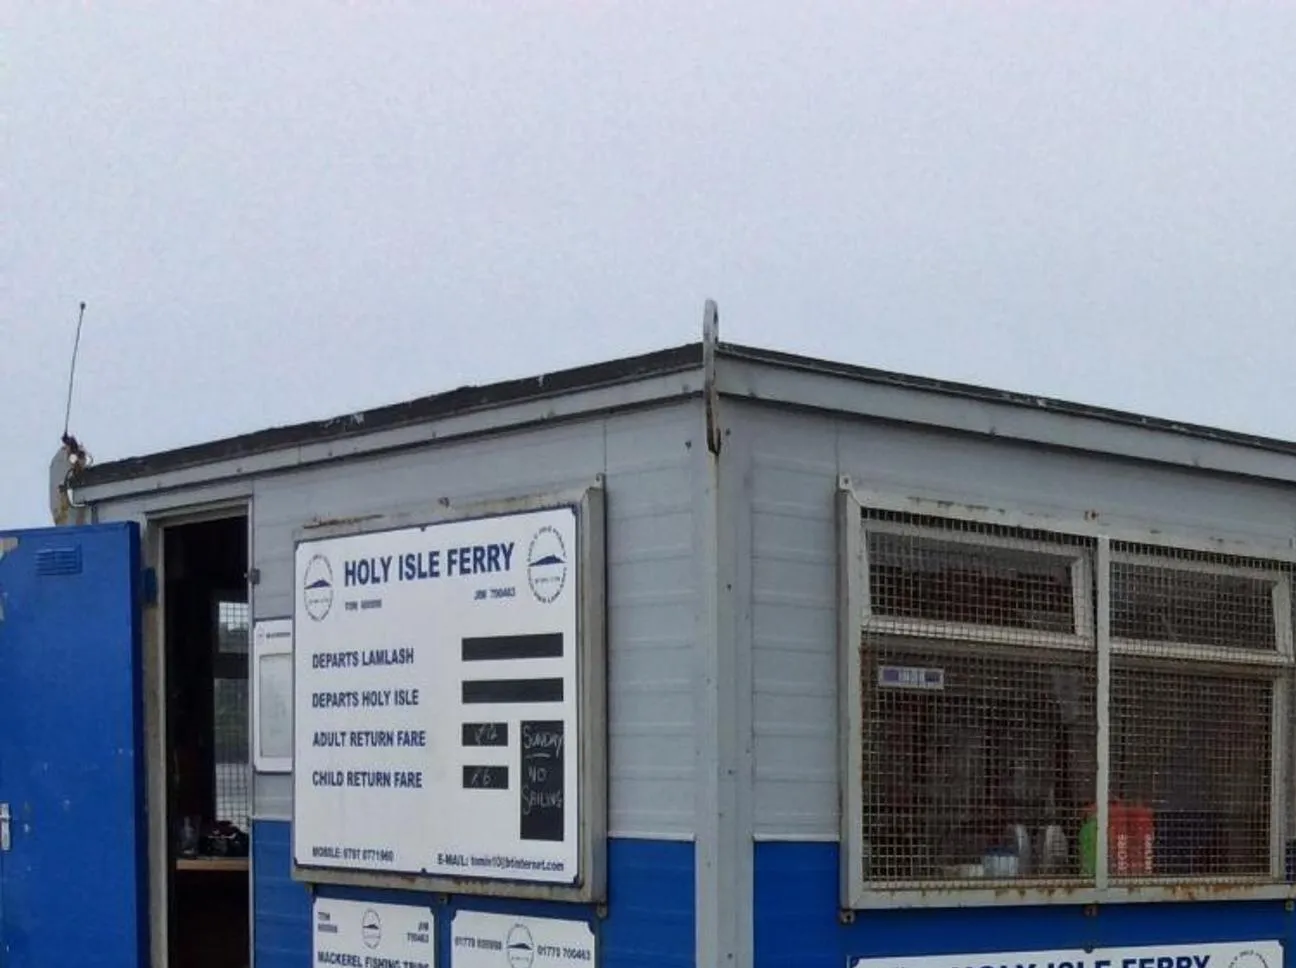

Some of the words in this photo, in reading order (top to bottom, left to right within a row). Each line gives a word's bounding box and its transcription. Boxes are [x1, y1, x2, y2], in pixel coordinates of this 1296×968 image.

[345, 556, 392, 586] HOLY
[399, 551, 440, 581] ISLE
[447, 542, 515, 576] FERRY
[312, 651, 359, 668] DEPARTS
[362, 648, 414, 666] LAMLASH
[312, 691, 359, 708] DEPARTS
[362, 690, 391, 706] HOLY
[394, 689, 419, 705] ISLE
[312, 731, 346, 747] ADULT
[350, 731, 394, 747] RETURN
[397, 730, 426, 747] FARE
[312, 770, 344, 787] CHILD
[346, 771, 391, 788] RETURN
[394, 771, 422, 788] FARE
[317, 951, 363, 968] MACKEREL
